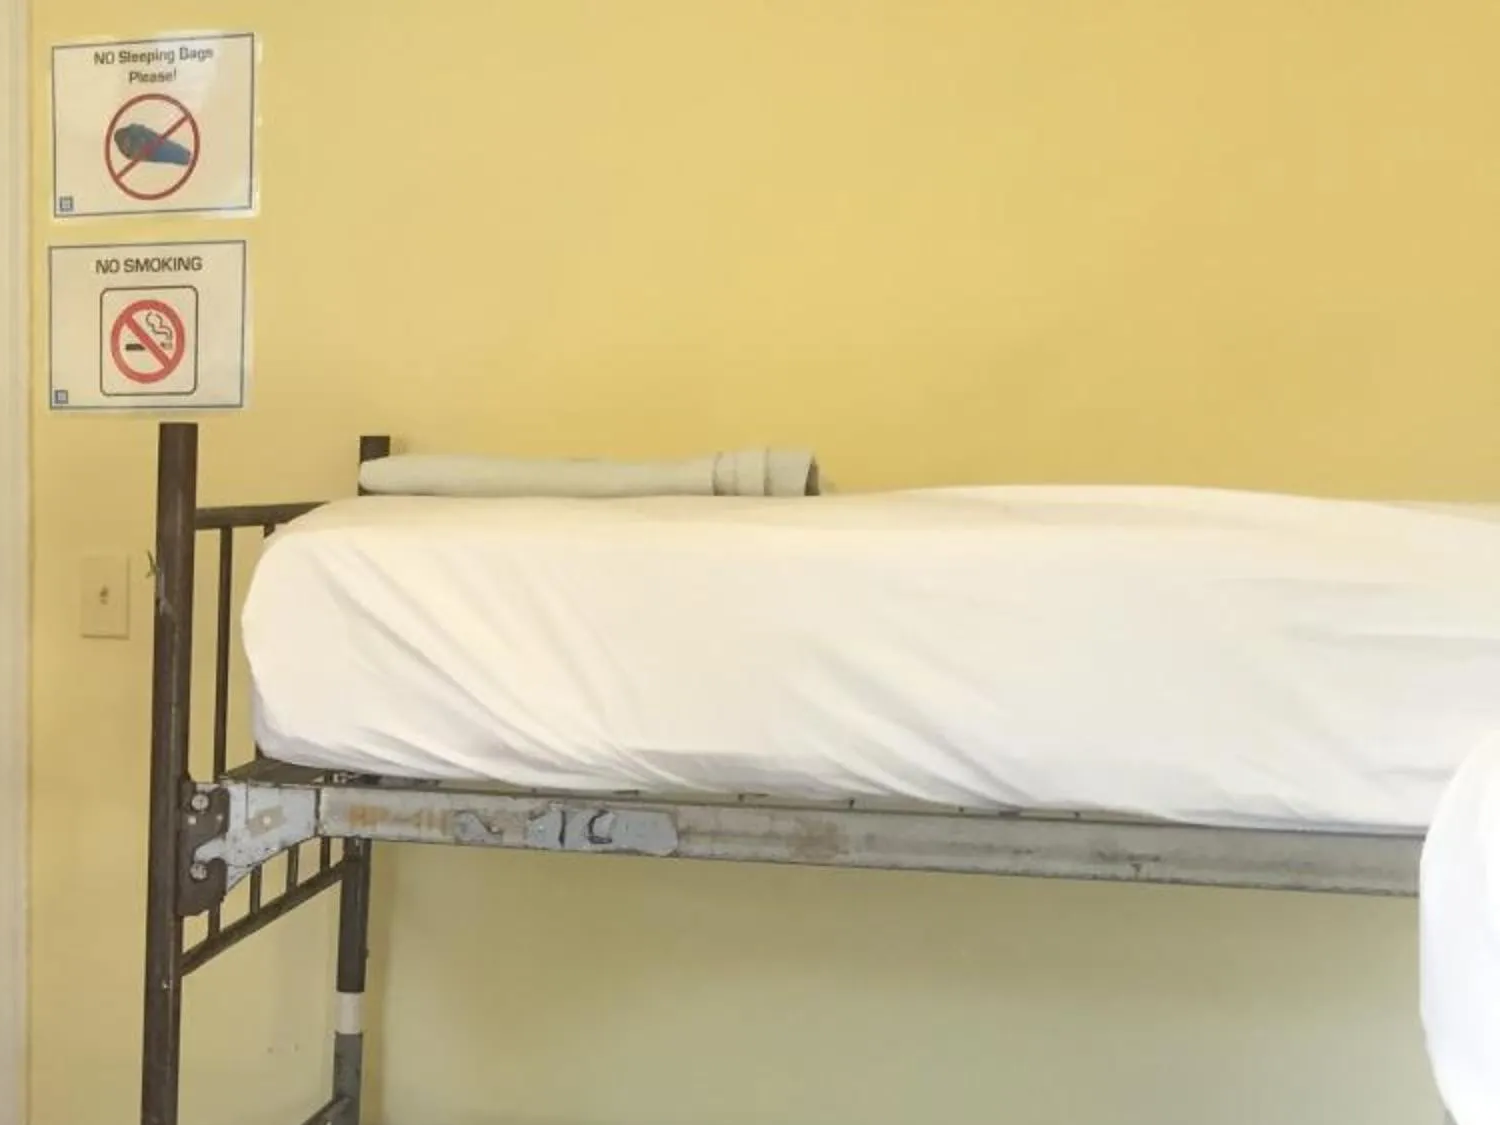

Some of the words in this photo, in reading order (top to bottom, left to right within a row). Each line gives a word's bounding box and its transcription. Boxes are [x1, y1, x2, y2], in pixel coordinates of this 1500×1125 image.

[94, 51, 115, 65] NO
[118, 48, 175, 65] Sleeping
[179, 46, 214, 62] Bags
[128, 68, 177, 84] Please!
[95, 259, 120, 274] NO
[123, 255, 203, 273] SMOKING
